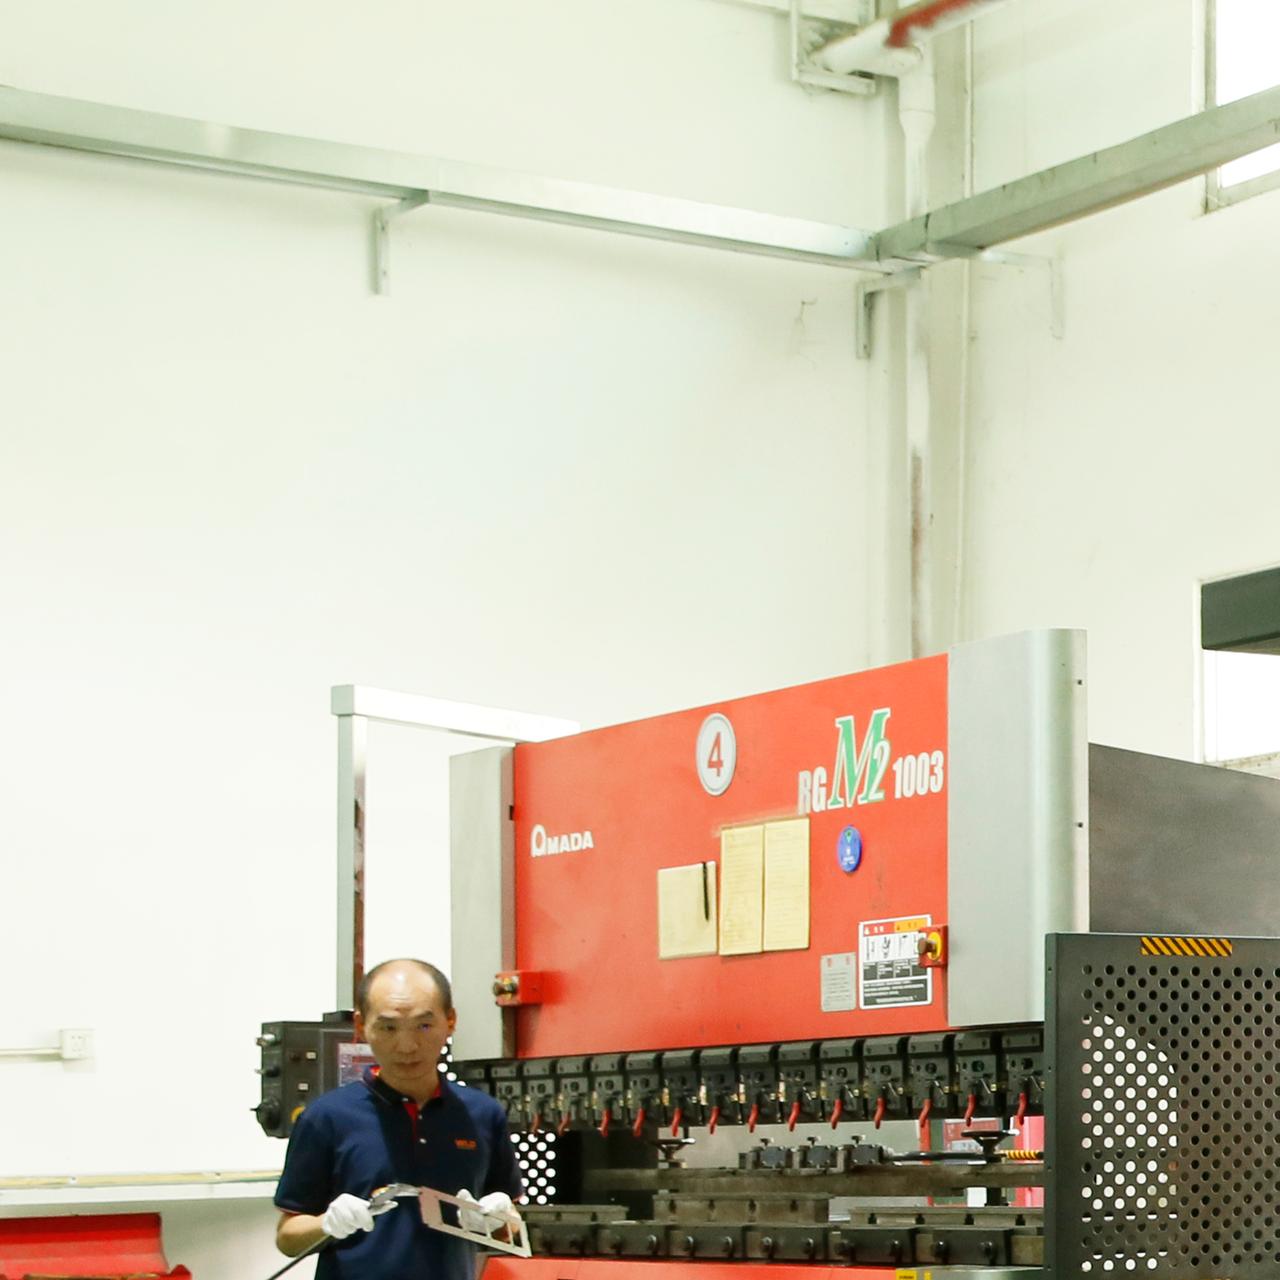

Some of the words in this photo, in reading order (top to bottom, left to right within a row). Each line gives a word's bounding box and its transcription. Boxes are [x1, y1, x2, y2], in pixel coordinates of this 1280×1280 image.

[707, 731, 724, 777] 4
[892, 750, 945, 799] 1003
[530, 823, 594, 858] AMADA
